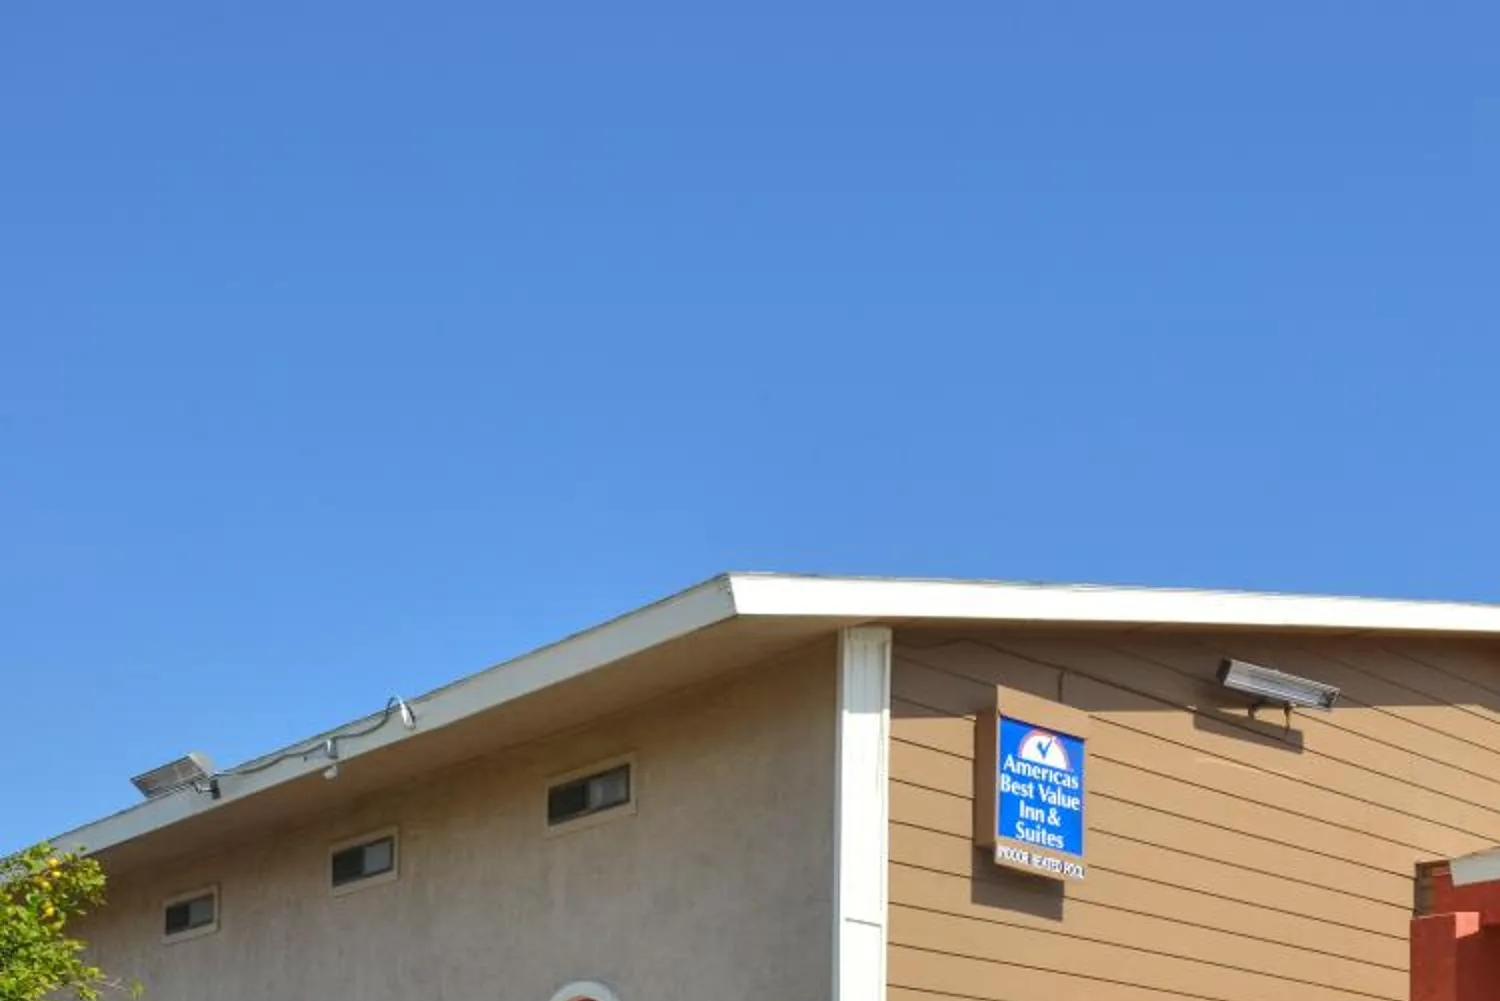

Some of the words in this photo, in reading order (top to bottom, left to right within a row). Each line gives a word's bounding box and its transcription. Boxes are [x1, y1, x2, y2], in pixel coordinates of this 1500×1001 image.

[1003, 753, 1079, 789] Americas
[1000, 772, 1033, 800] Best
[1037, 783, 1081, 811] Value
[1019, 799, 1045, 824] Inn
[1047, 807, 1062, 828] &
[1015, 820, 1065, 849] Suites
